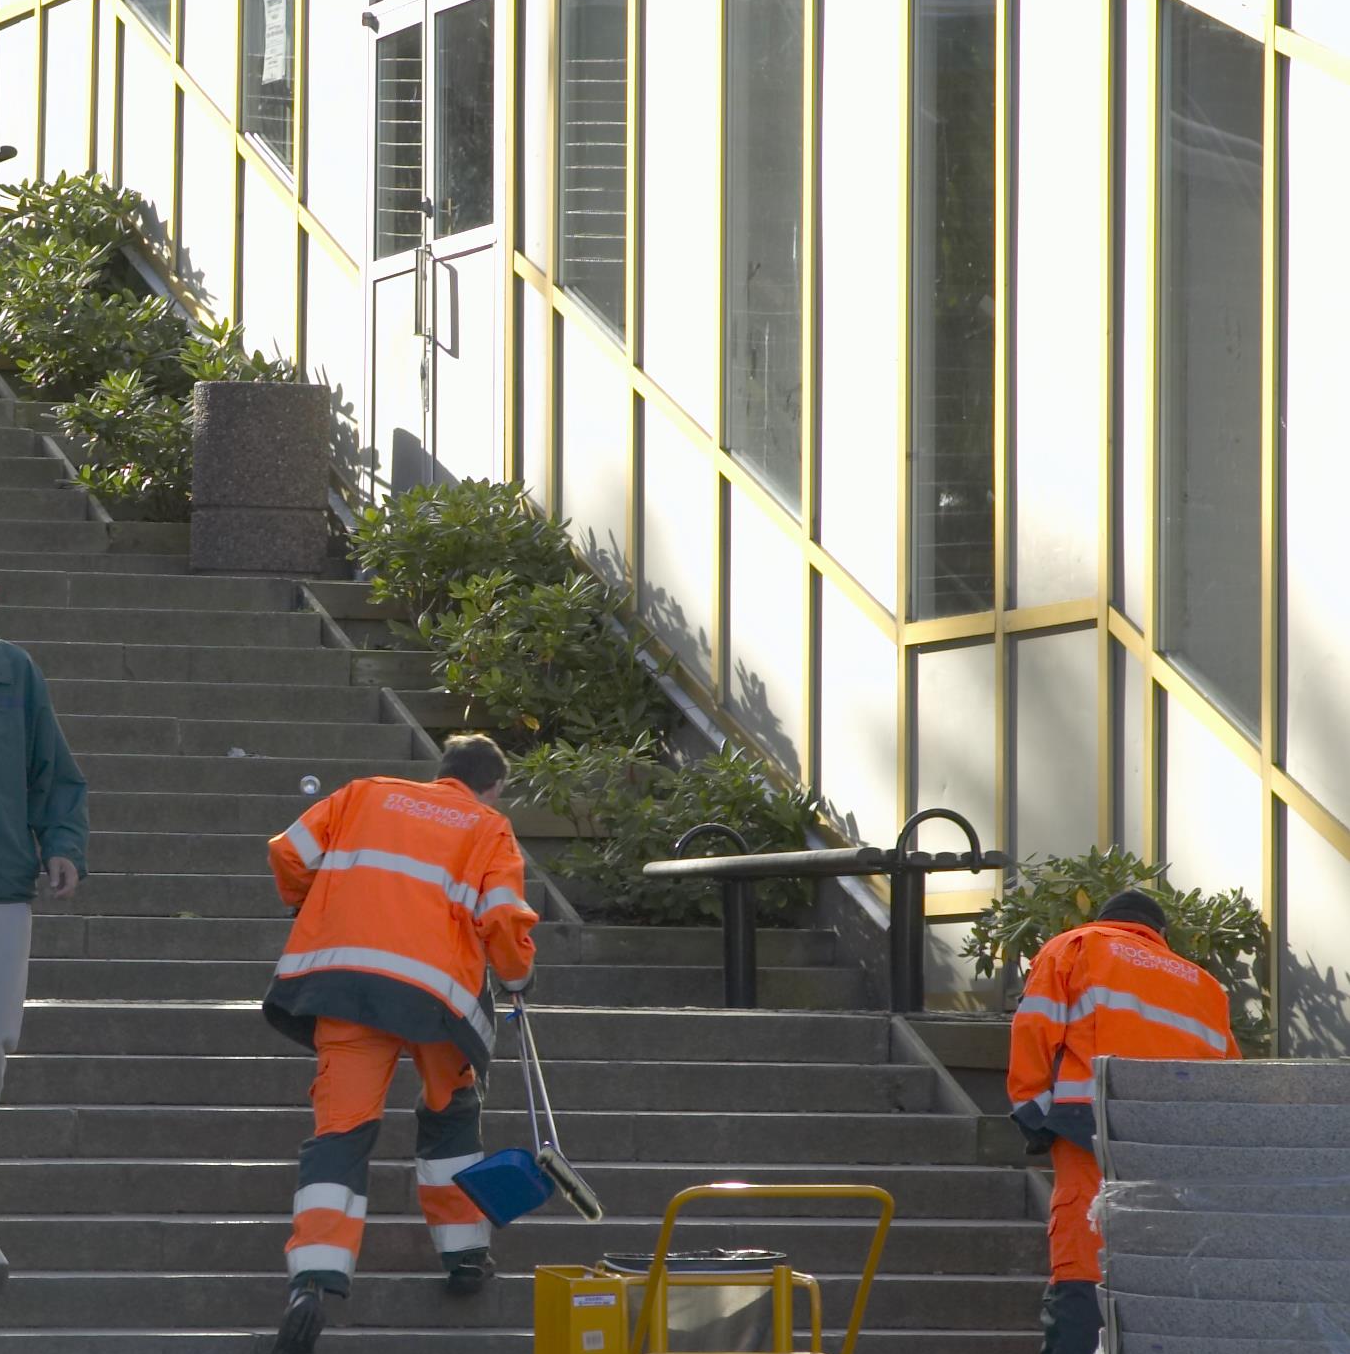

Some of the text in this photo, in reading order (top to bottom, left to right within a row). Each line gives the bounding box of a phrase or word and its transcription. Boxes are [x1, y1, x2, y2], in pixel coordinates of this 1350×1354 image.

[386, 793, 480, 822] STOCKHOLM
[1110, 942, 1199, 976] STOCKHOLM
[1133, 958, 1159, 970] OCH
